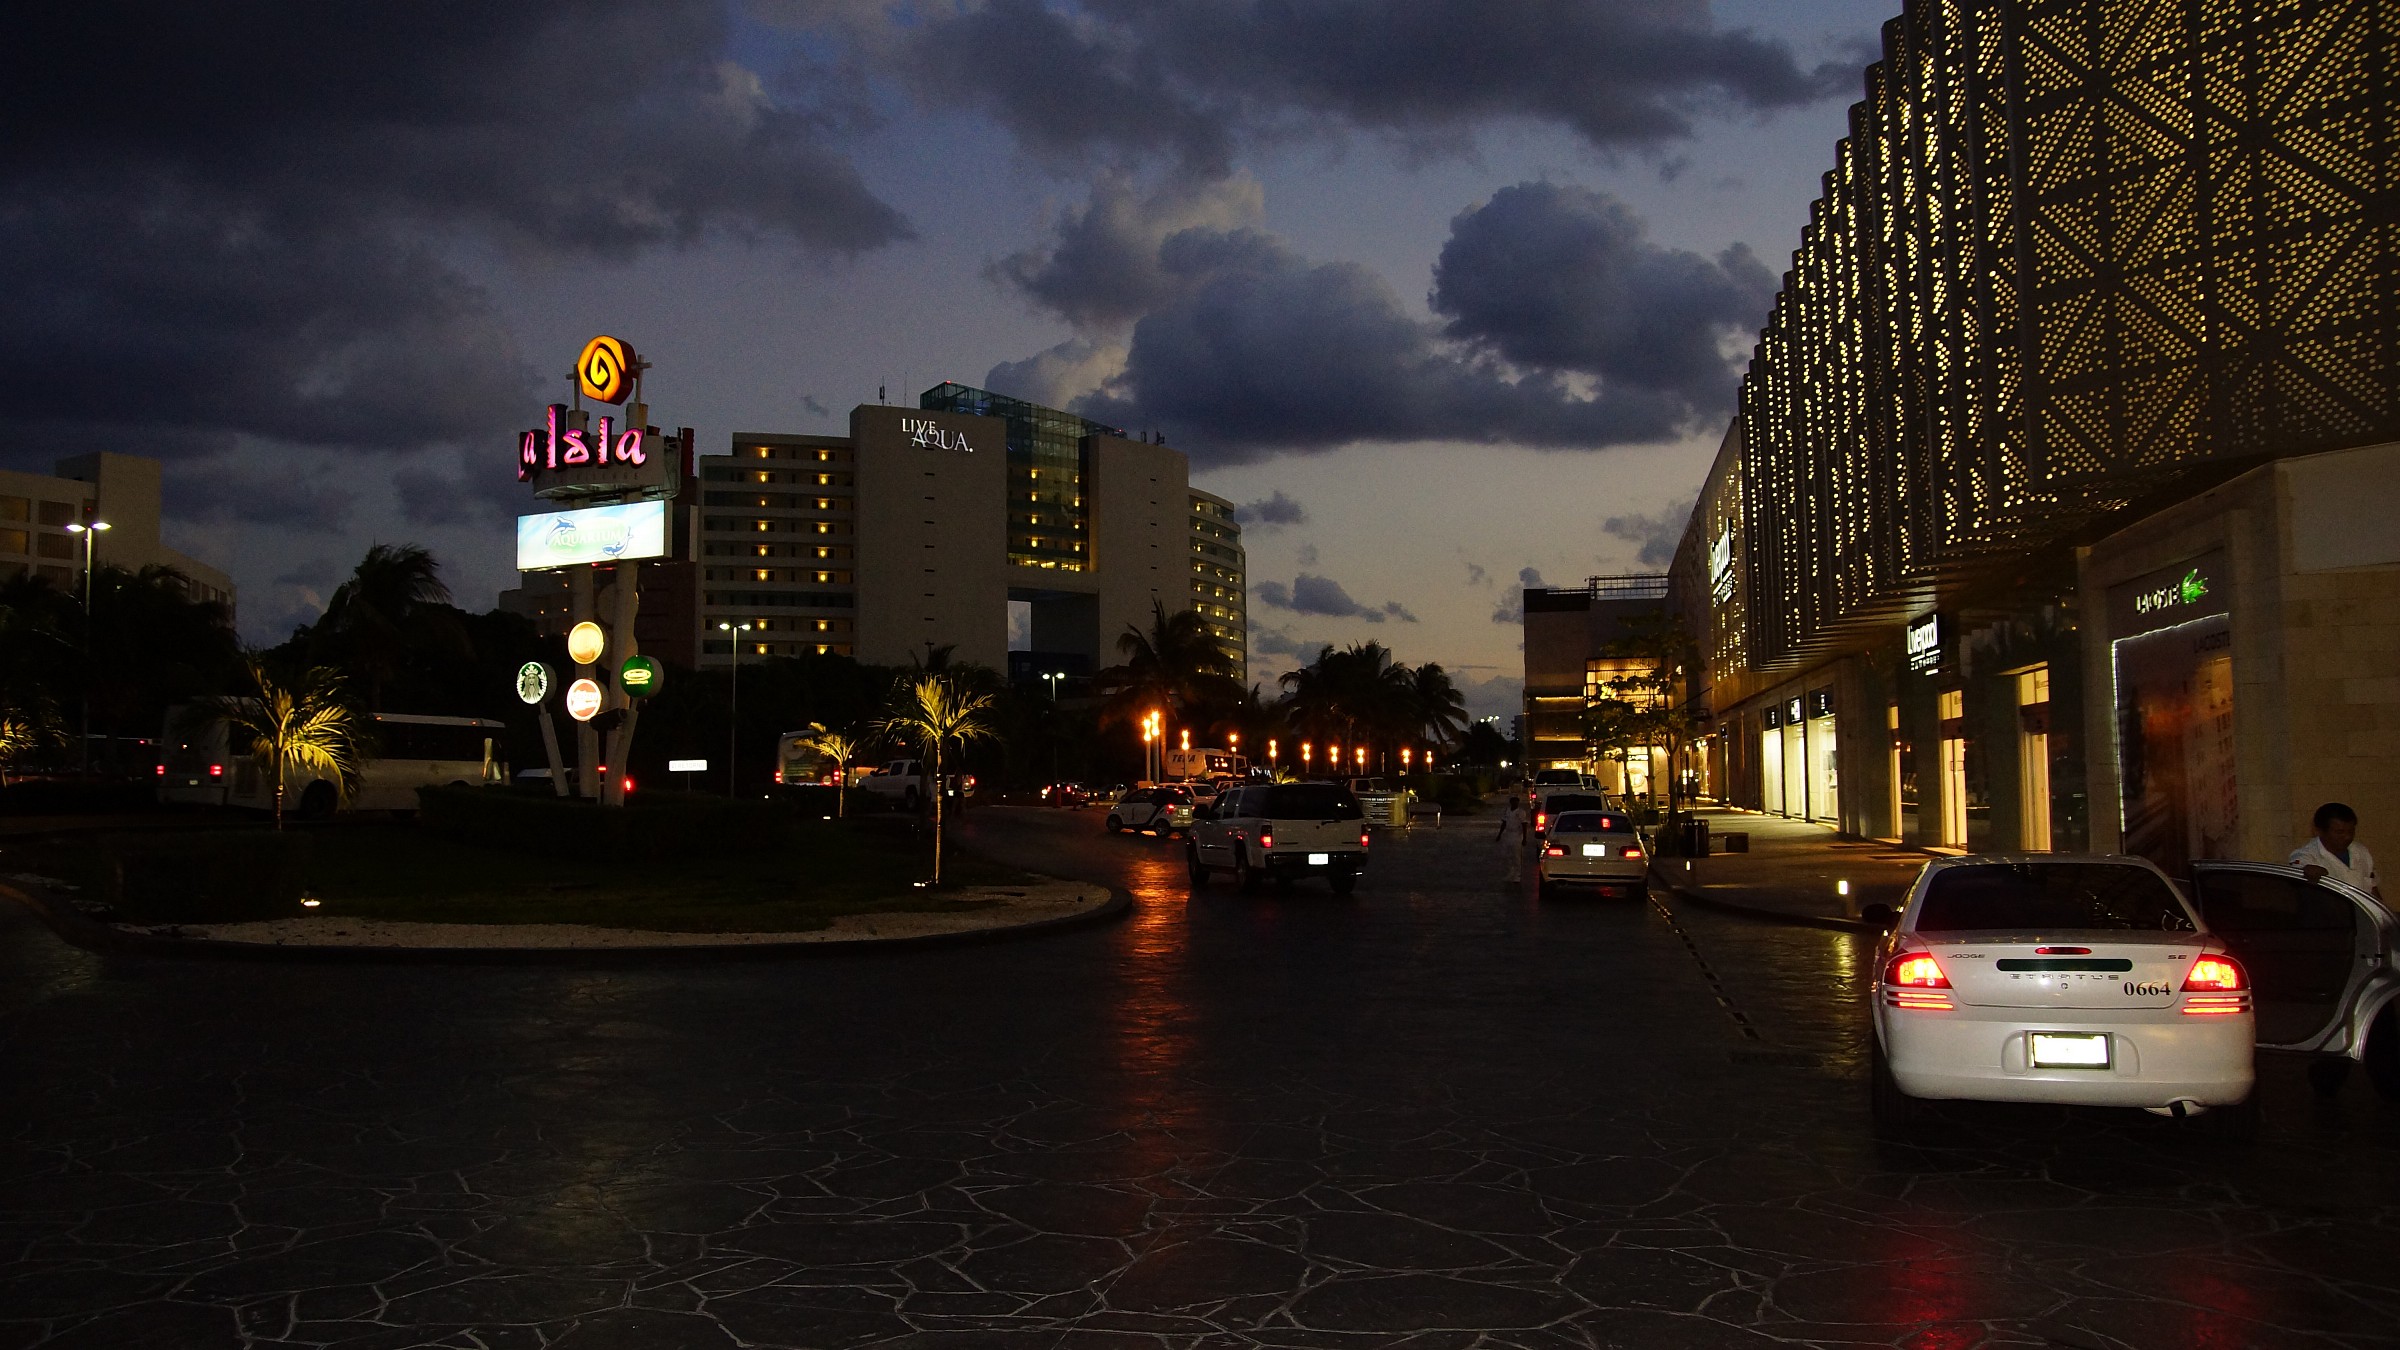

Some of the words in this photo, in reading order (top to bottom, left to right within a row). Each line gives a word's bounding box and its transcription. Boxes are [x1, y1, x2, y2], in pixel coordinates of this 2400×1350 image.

[902, 418, 936, 435] LIVE
[2010, 972, 2120, 981] STRATUS
[2123, 981, 2171, 996] 0664
